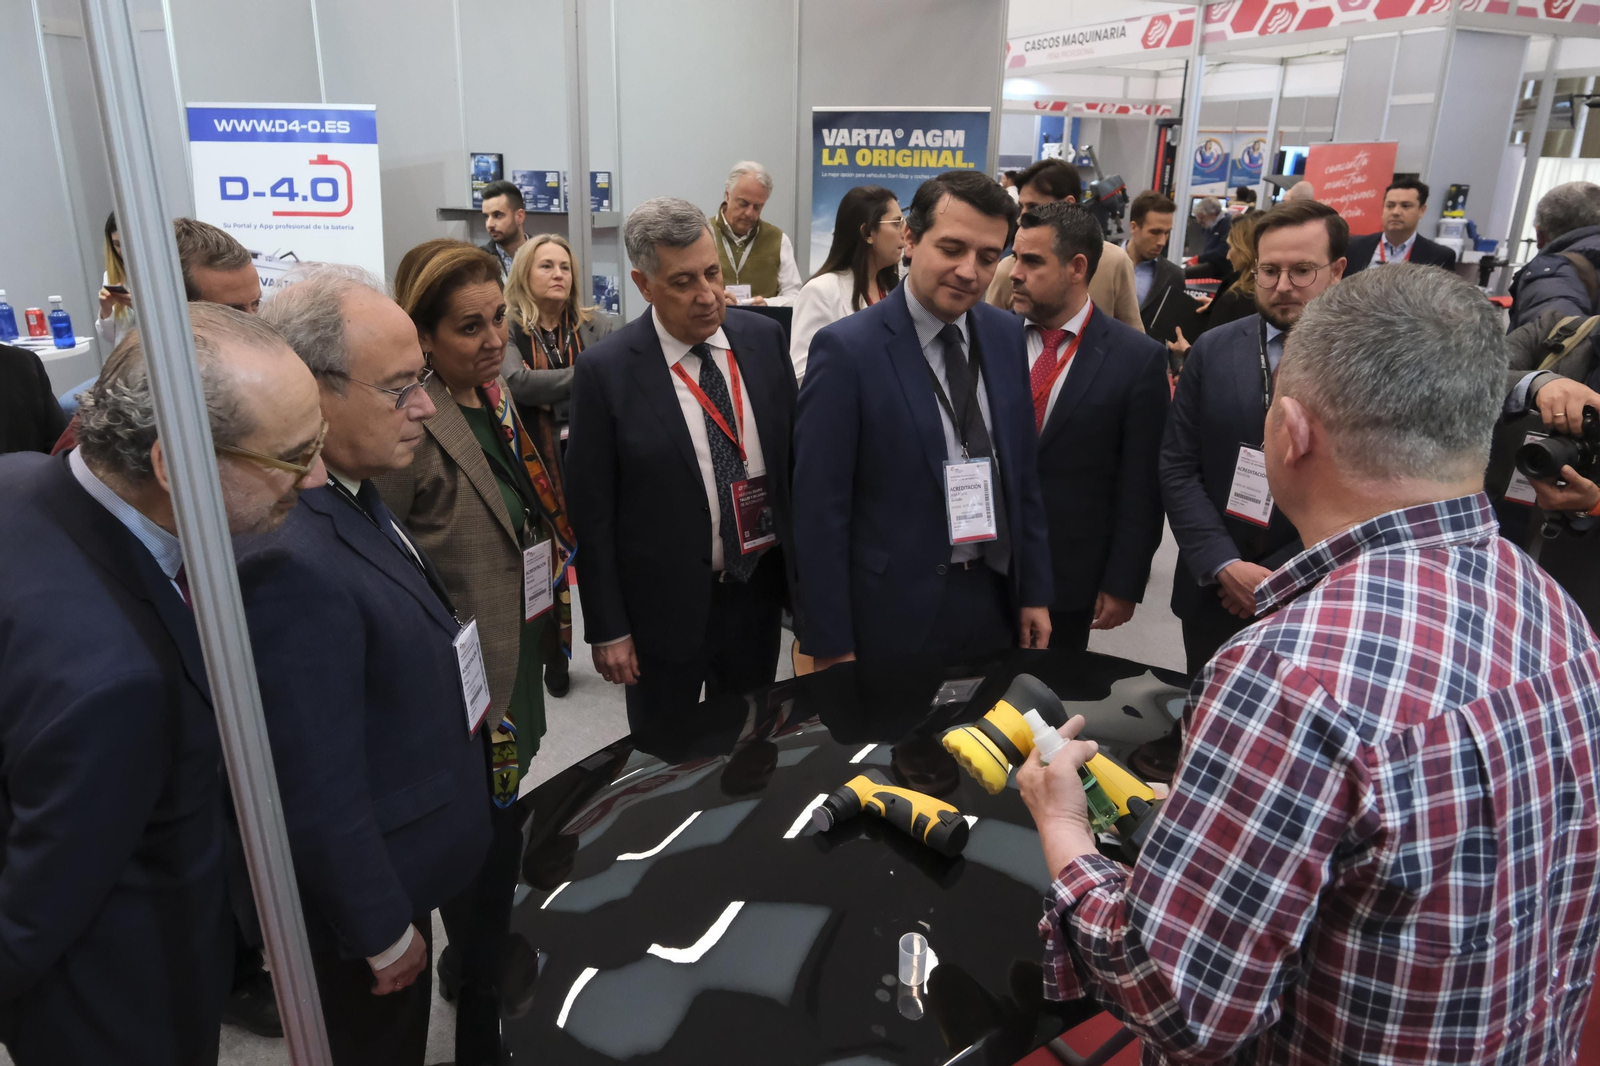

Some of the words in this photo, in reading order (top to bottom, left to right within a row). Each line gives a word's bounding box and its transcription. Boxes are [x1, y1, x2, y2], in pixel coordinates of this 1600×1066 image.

[1024, 36, 1060, 52] CASCOS
[1062, 25, 1126, 46] MAQUINARIA
[908, 129, 965, 147] AGM
[822, 148, 849, 166] LA
[855, 149, 975, 168] ORIGINAL.
[259, 223, 274, 231] App
[275, 223, 311, 231] profesional
[950, 484, 982, 492] ACREDITACIÓN
